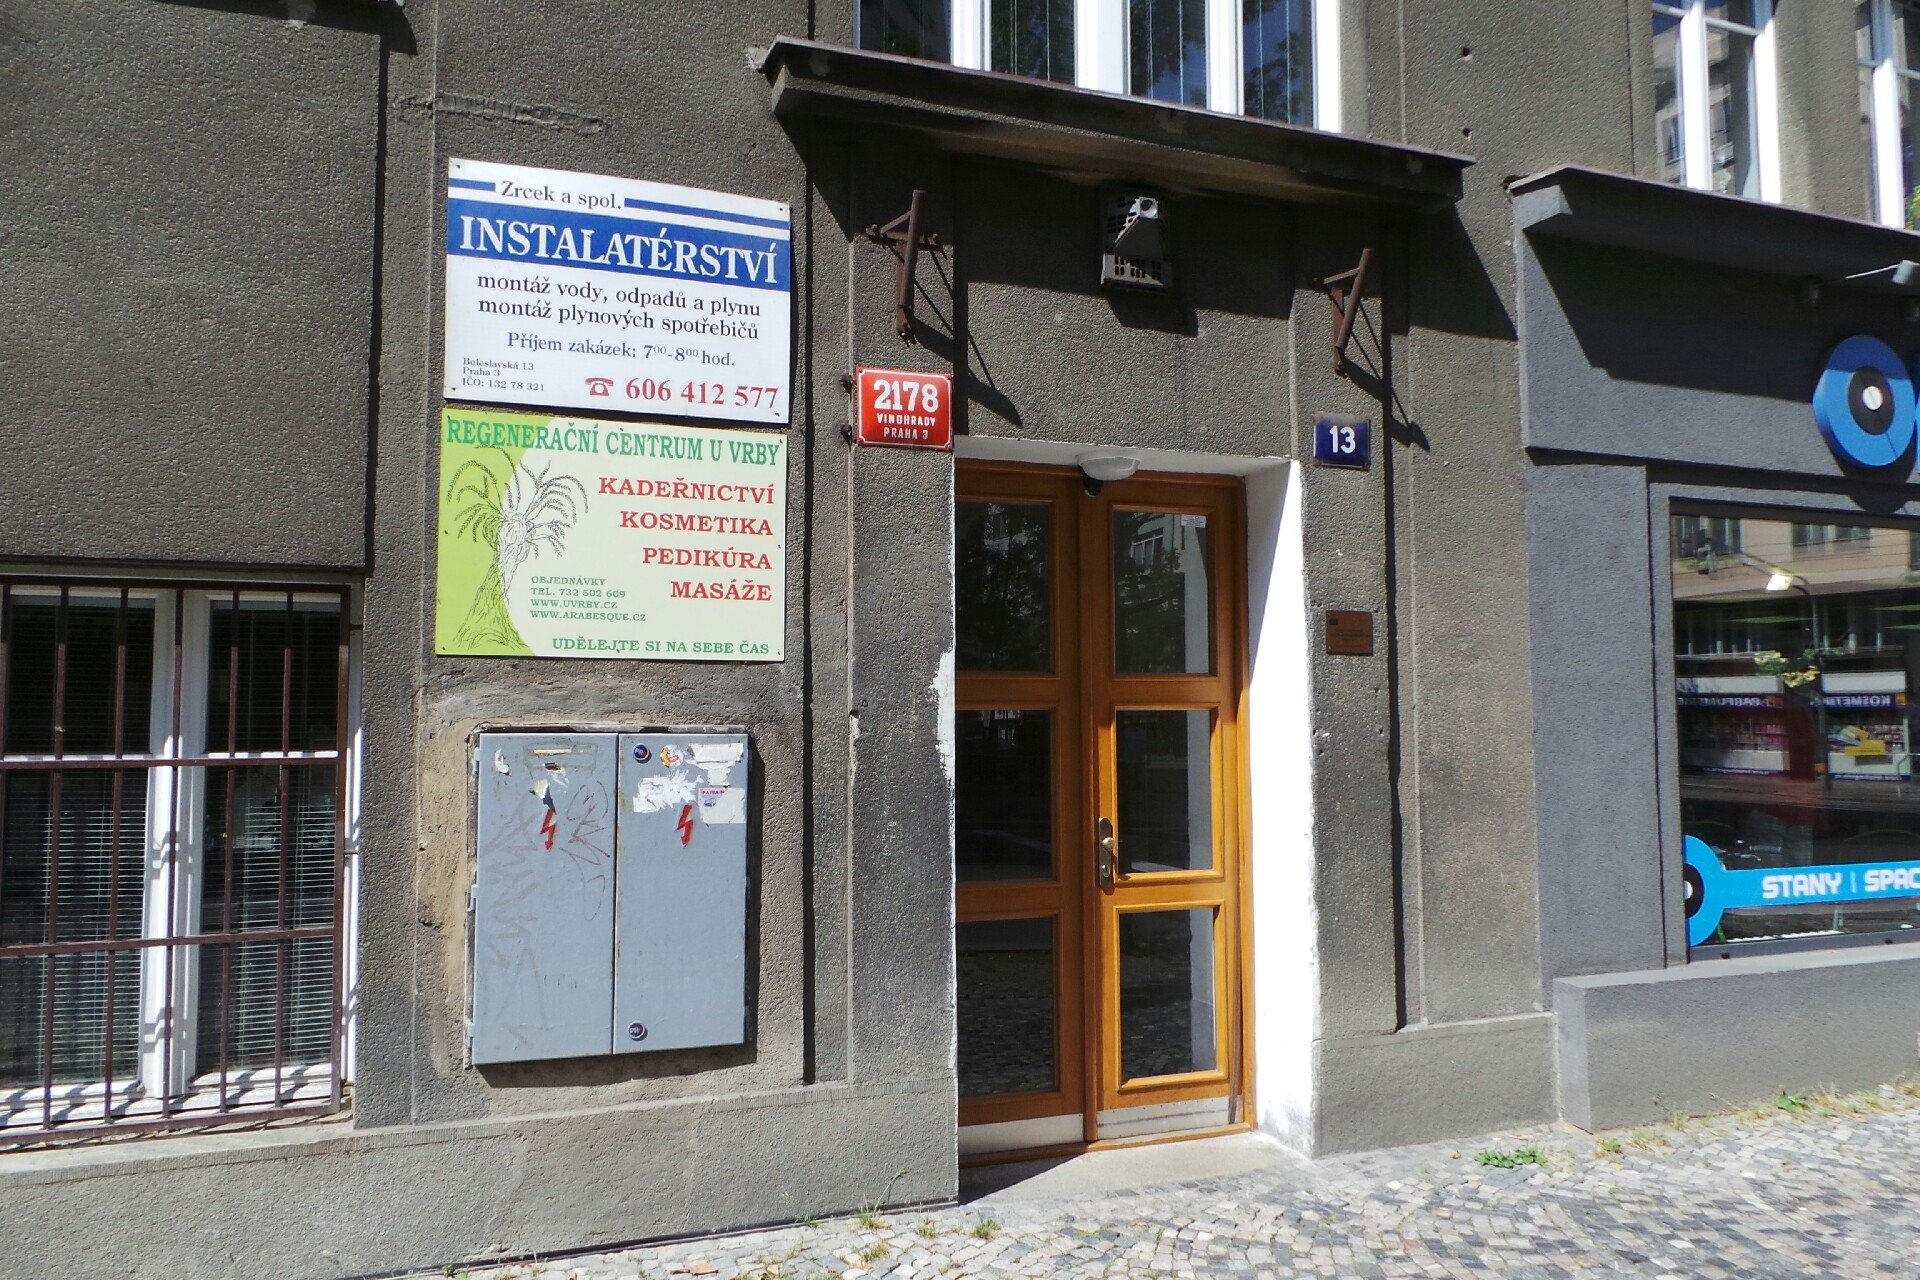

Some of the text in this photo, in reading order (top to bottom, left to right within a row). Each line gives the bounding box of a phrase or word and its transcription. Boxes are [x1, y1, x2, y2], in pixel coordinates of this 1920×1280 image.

[501, 180, 622, 210] Zrcek a spol.
[459, 215, 777, 284] INSTALATÉRSTVÍ
[477, 275, 761, 317] montáž vody, odpadů a plynu
[478, 299, 759, 340] montáž plynových spotřebičů
[507, 331, 562, 351] Příjem
[568, 339, 636, 358] zakázek:
[701, 350, 735, 366] hod.
[462, 366, 500, 377] Praha 3
[463, 357, 534, 371] Boleslavská 13
[462, 376, 545, 391] IČO: 132 78 321
[625, 377, 779, 409] 606 412 577
[873, 379, 939, 413] 2178
[876, 413, 936, 427] VINOHRADY
[447, 419, 780, 466] REGENERAČNÍ CENTRUM U VRBY
[883, 427, 929, 440] PRAHA 3
[1329, 425, 1356, 454] 13
[598, 477, 774, 504] KADEŘNICTVÍ
[619, 511, 774, 536] KOSMETIKA
[642, 547, 773, 570] PEDIKÚRA
[530, 587, 626, 598] TEL. 732 502 609
[531, 576, 606, 586] OBJEDNÁVKY
[670, 578, 772, 601] MASÁŽE
[530, 599, 618, 609] WWW.UVRBY.CZ
[530, 610, 647, 622] WWW.ARABESQUE.CZ
[552, 636, 769, 654] UDĚLEJTE SI NA SEBE ČAS
[1762, 872, 1843, 899] STANY
